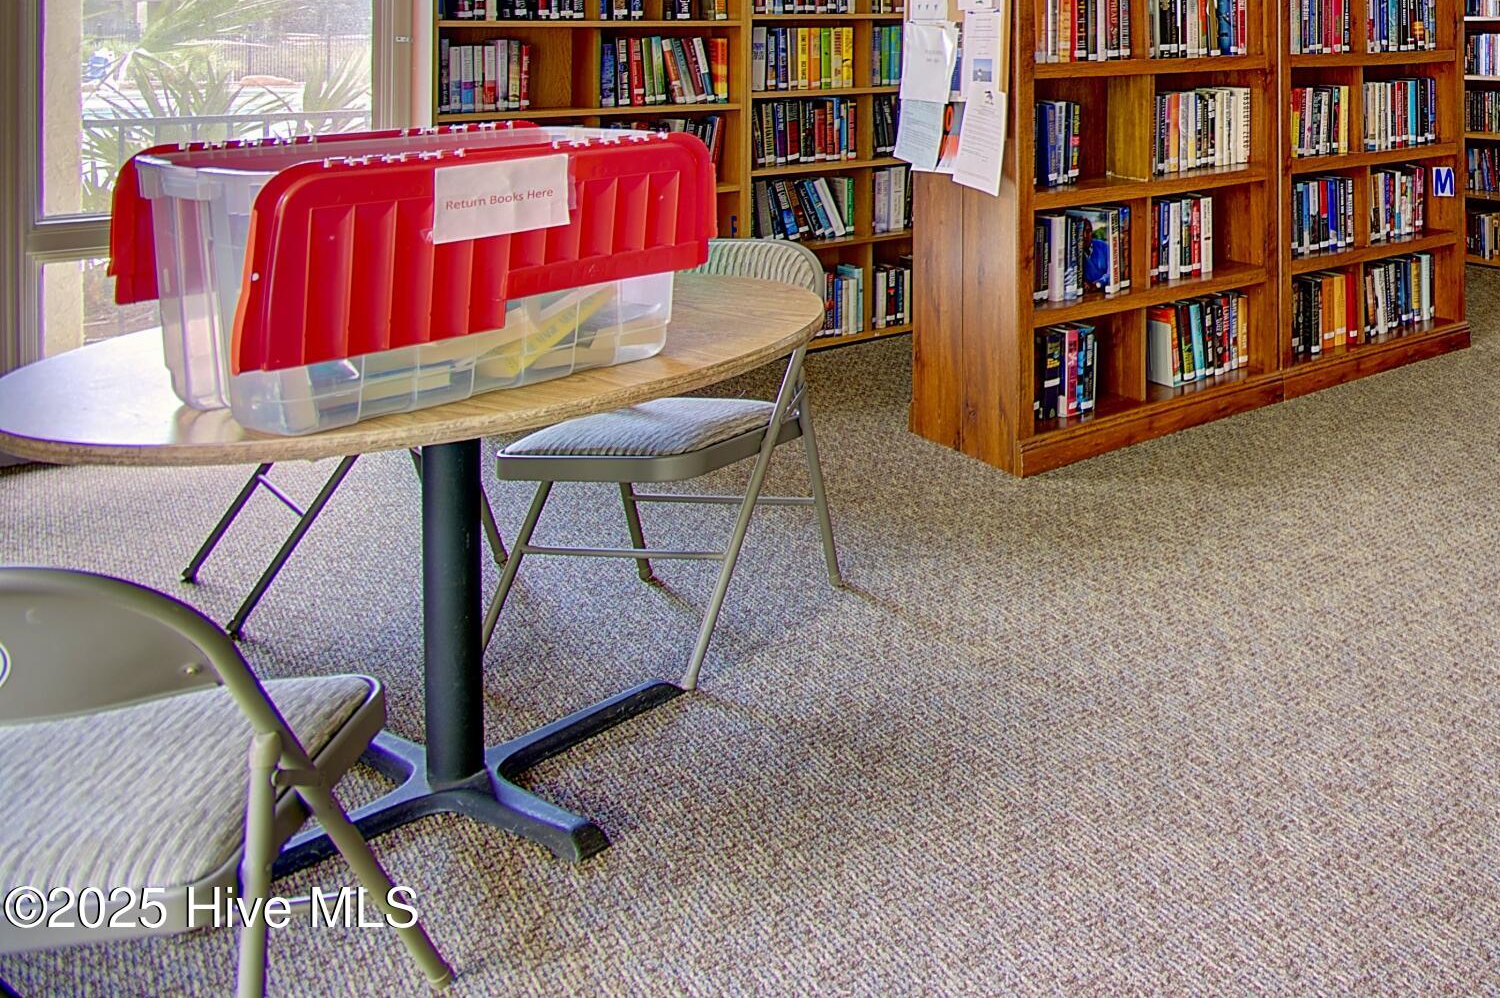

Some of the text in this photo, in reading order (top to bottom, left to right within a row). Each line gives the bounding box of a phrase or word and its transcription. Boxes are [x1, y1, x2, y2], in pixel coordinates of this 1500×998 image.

[1302, 0, 1310, 21] McBain
[1435, 168, 1454, 196] M
[446, 188, 554, 211] Return Books Here
